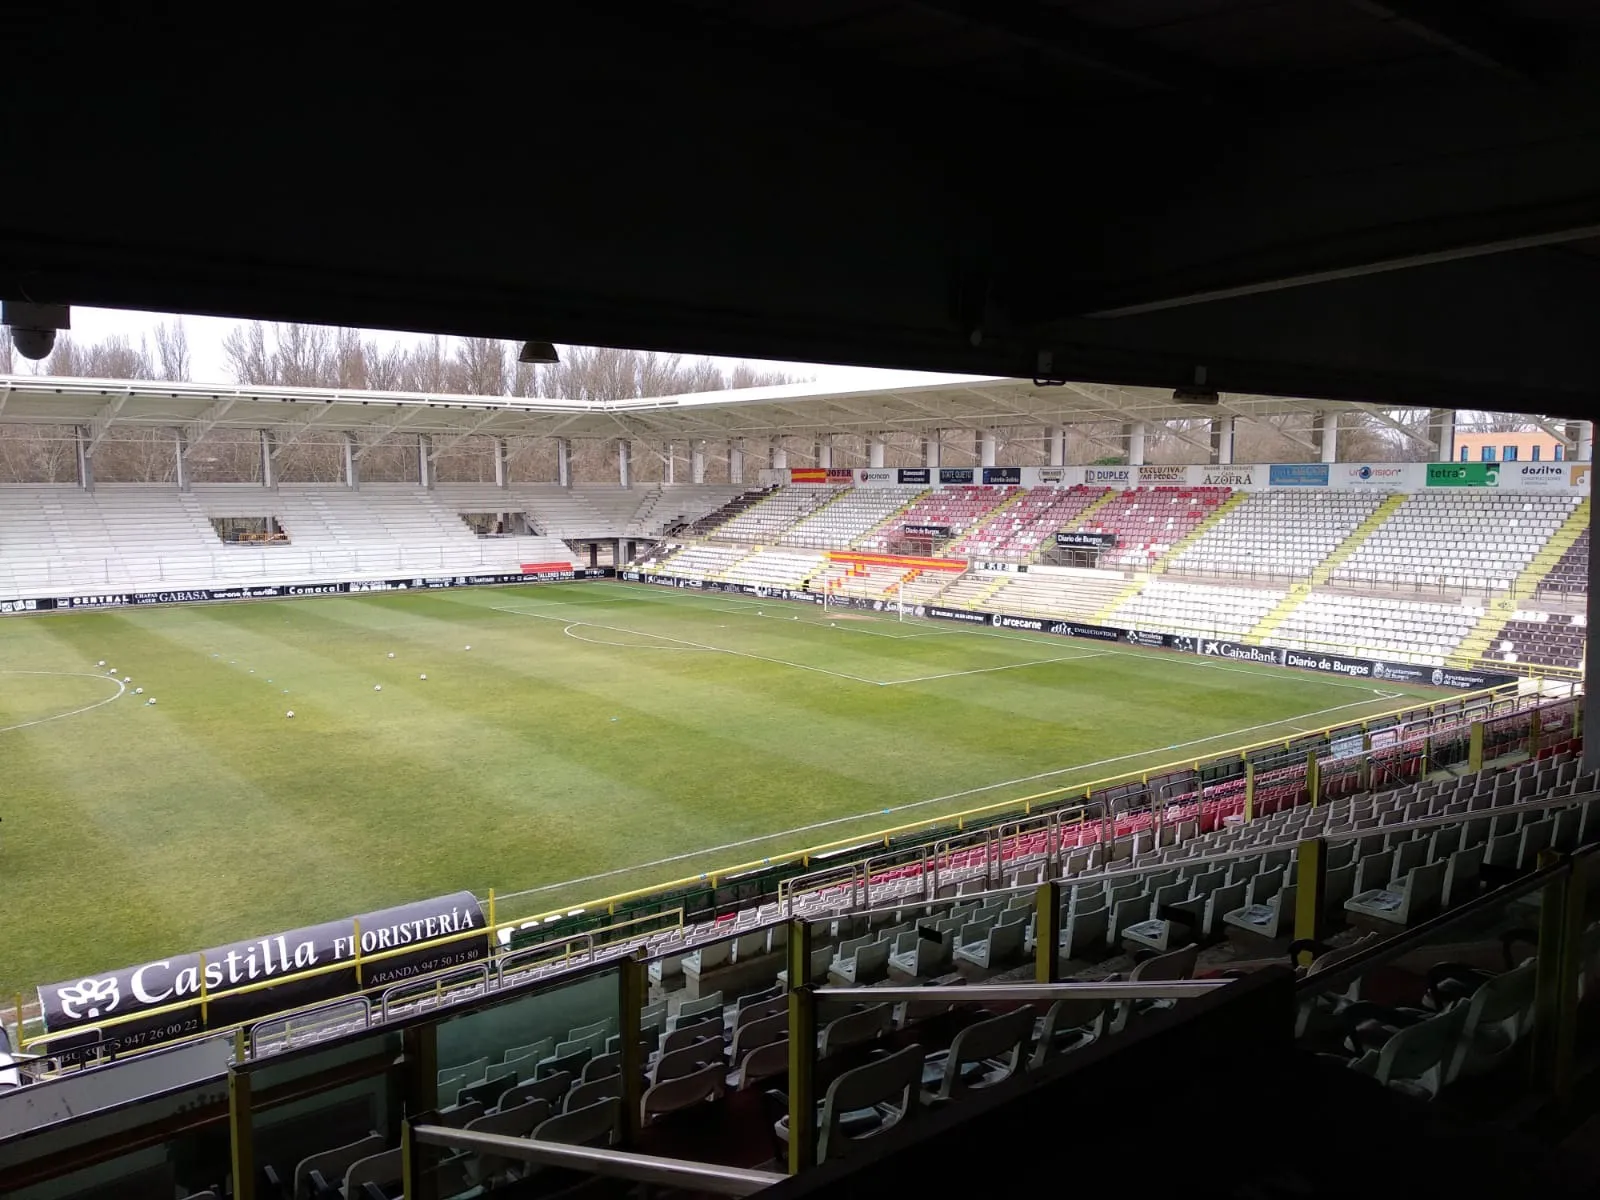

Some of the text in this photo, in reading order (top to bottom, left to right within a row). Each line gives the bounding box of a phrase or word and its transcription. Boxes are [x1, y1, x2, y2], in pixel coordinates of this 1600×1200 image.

[1097, 471, 1129, 480] DUPLEX
[1521, 466, 1562, 475] dasilva
[1203, 474, 1253, 485] AZOFRA
[1057, 534, 1074, 543] Diario
[289, 584, 340, 594] Comacal
[72, 594, 129, 605] CENTRAL
[159, 590, 209, 602] GABASA
[1003, 617, 1042, 630] arcecarne
[1220, 643, 1277, 663] CaixaBank
[1288, 655, 1369, 676] Diario de Burgos
[131, 907, 474, 1004] Castilla FLORISTERÍA
[370, 950, 479, 984] ARANDA 947 50 15 80
[124, 1032, 146, 1046] 947
[151, 1028, 164, 1041] 26
[167, 1023, 182, 1036] 00
[184, 1018, 198, 1031] 22
